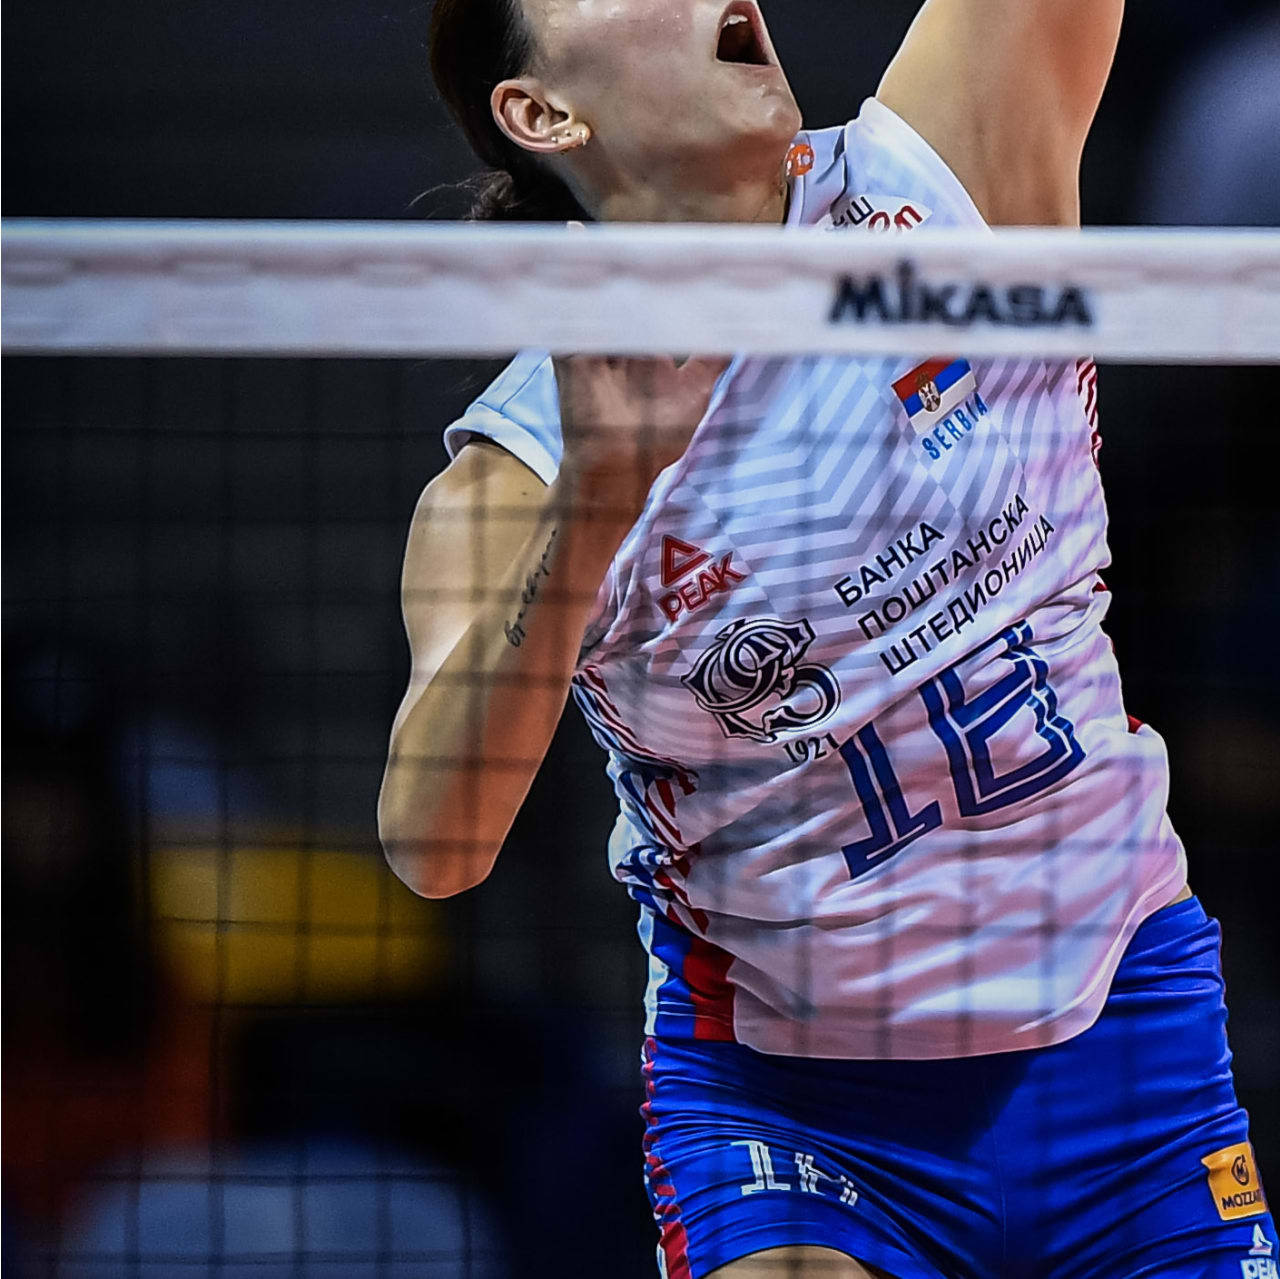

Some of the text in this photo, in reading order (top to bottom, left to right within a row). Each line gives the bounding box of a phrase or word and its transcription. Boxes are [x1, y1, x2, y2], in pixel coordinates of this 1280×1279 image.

[921, 392, 988, 460] SERBIA
[655, 551, 747, 621] PEAK
[833, 521, 945, 608] БАНКА
[857, 493, 1030, 640] ПОШТАНСКА
[880, 514, 1055, 676] ШТЕДИОНИЦА
